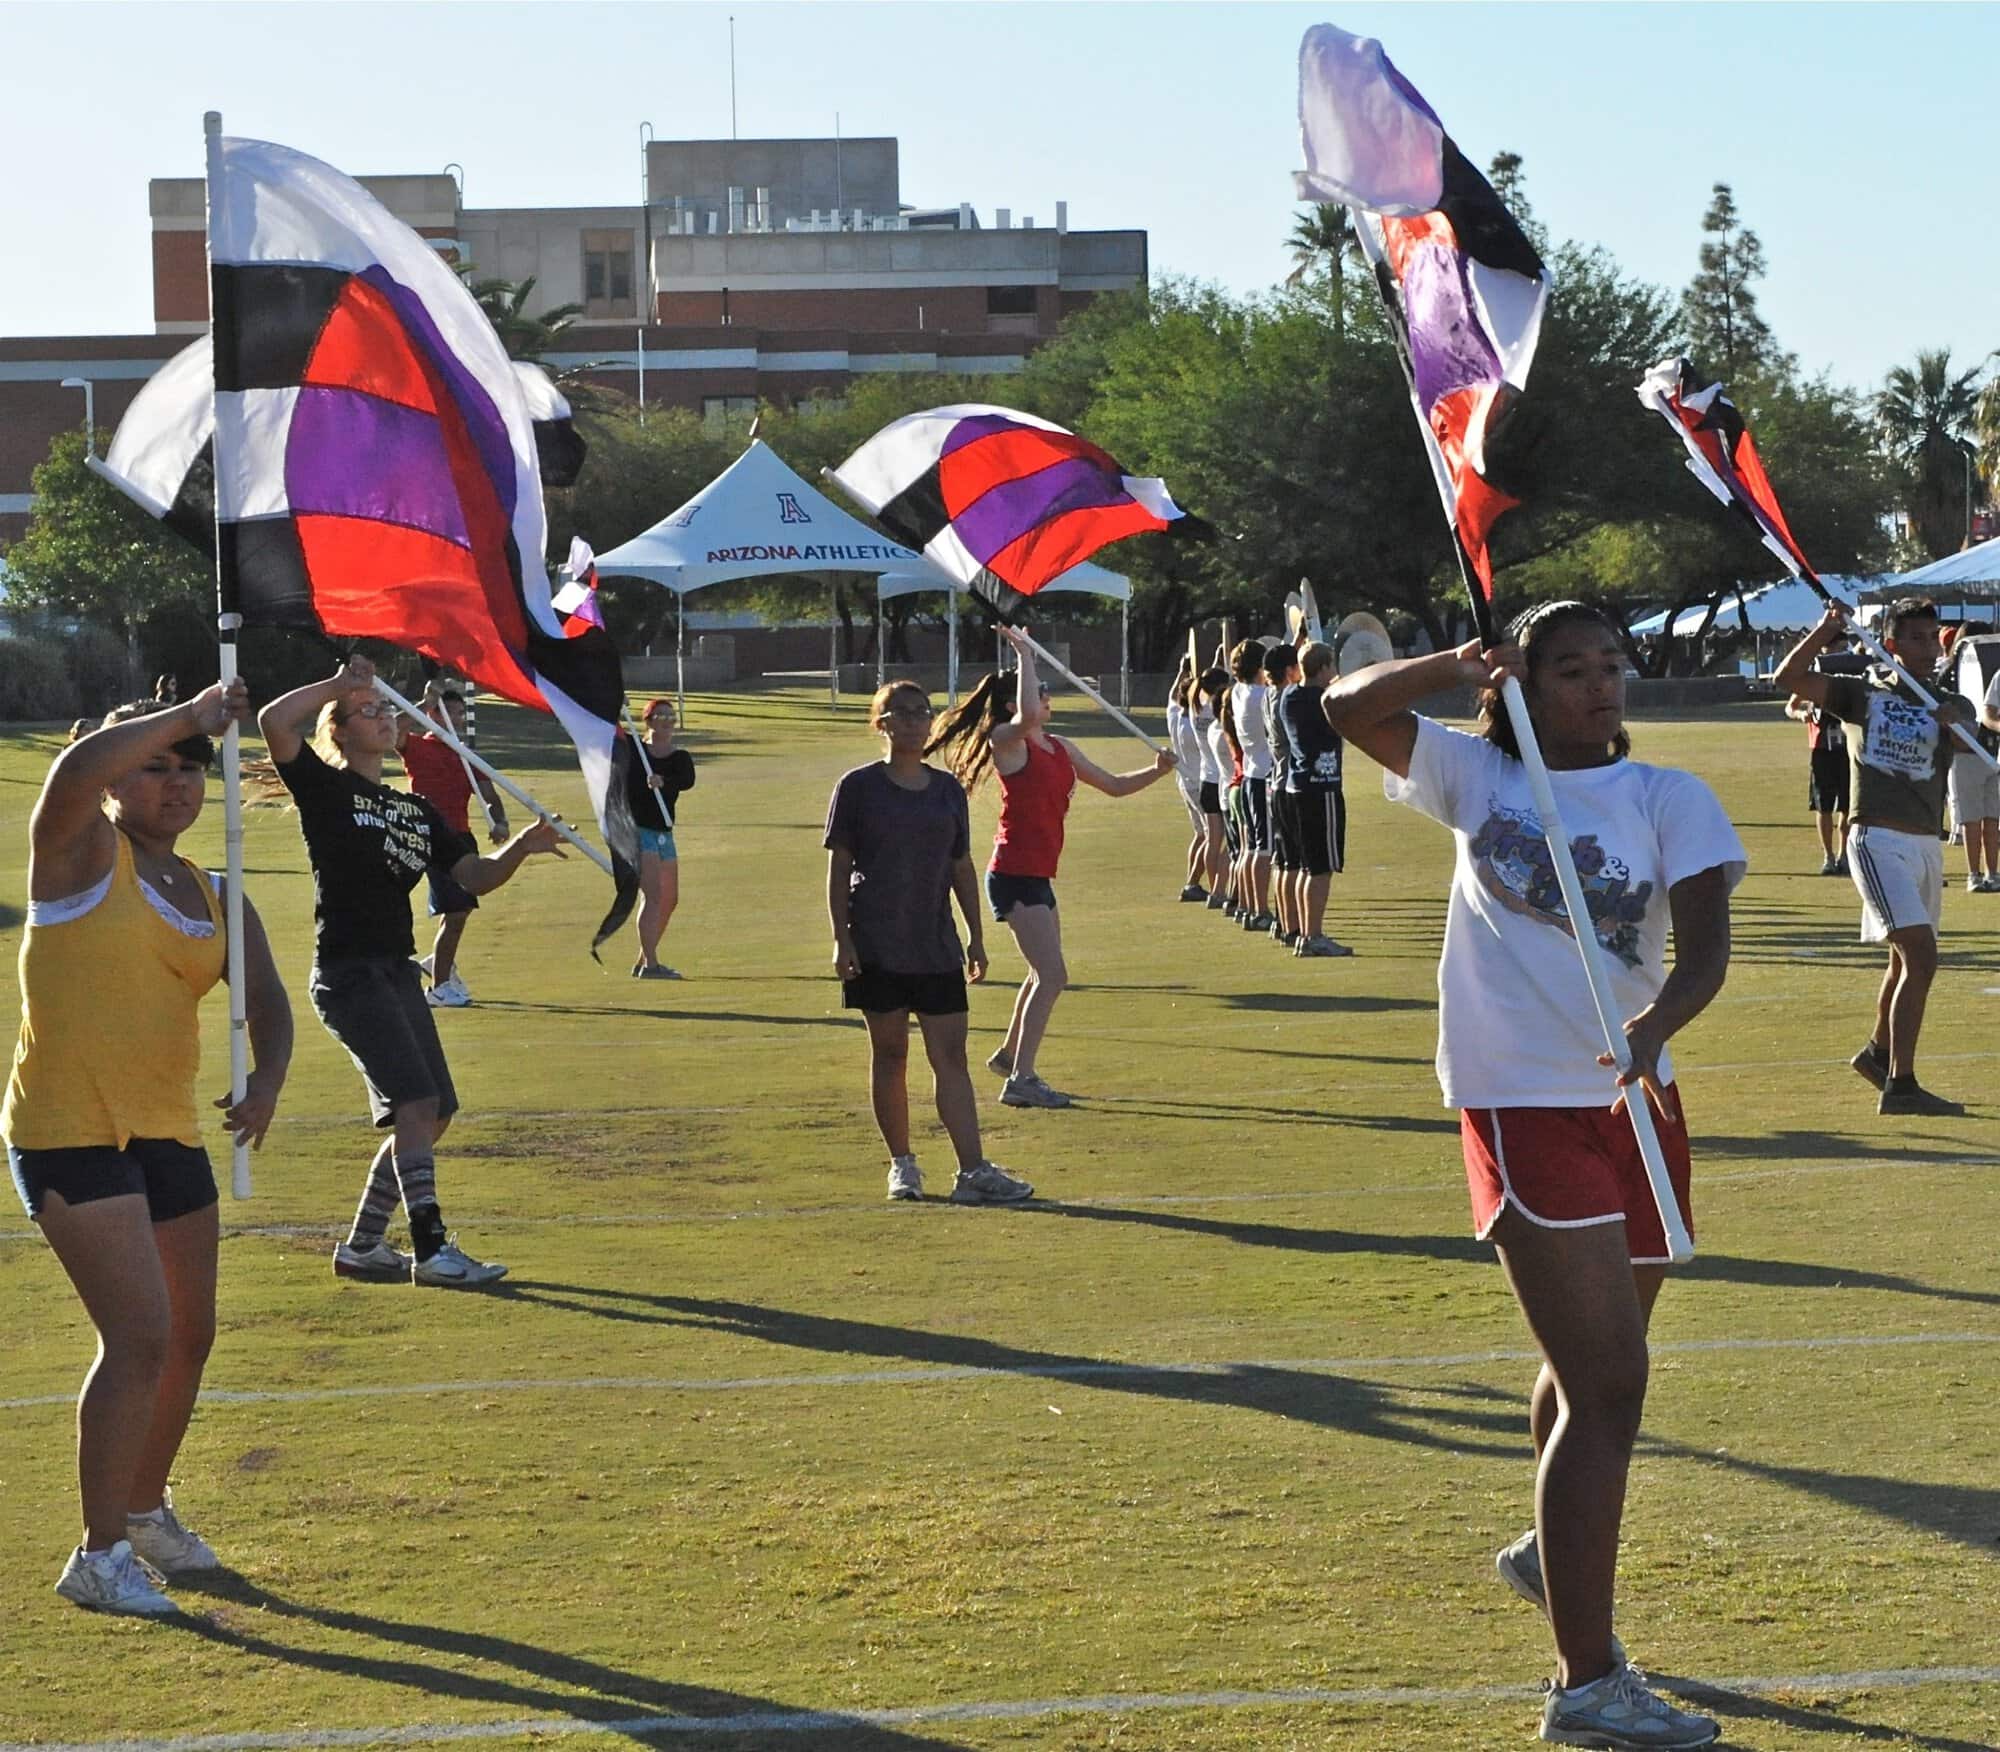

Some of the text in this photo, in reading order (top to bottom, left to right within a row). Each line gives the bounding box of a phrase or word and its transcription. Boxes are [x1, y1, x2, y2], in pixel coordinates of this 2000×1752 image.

[776, 493, 812, 523] A
[706, 545, 802, 563] ARIZONA
[1468, 812, 1605, 876] Trak
